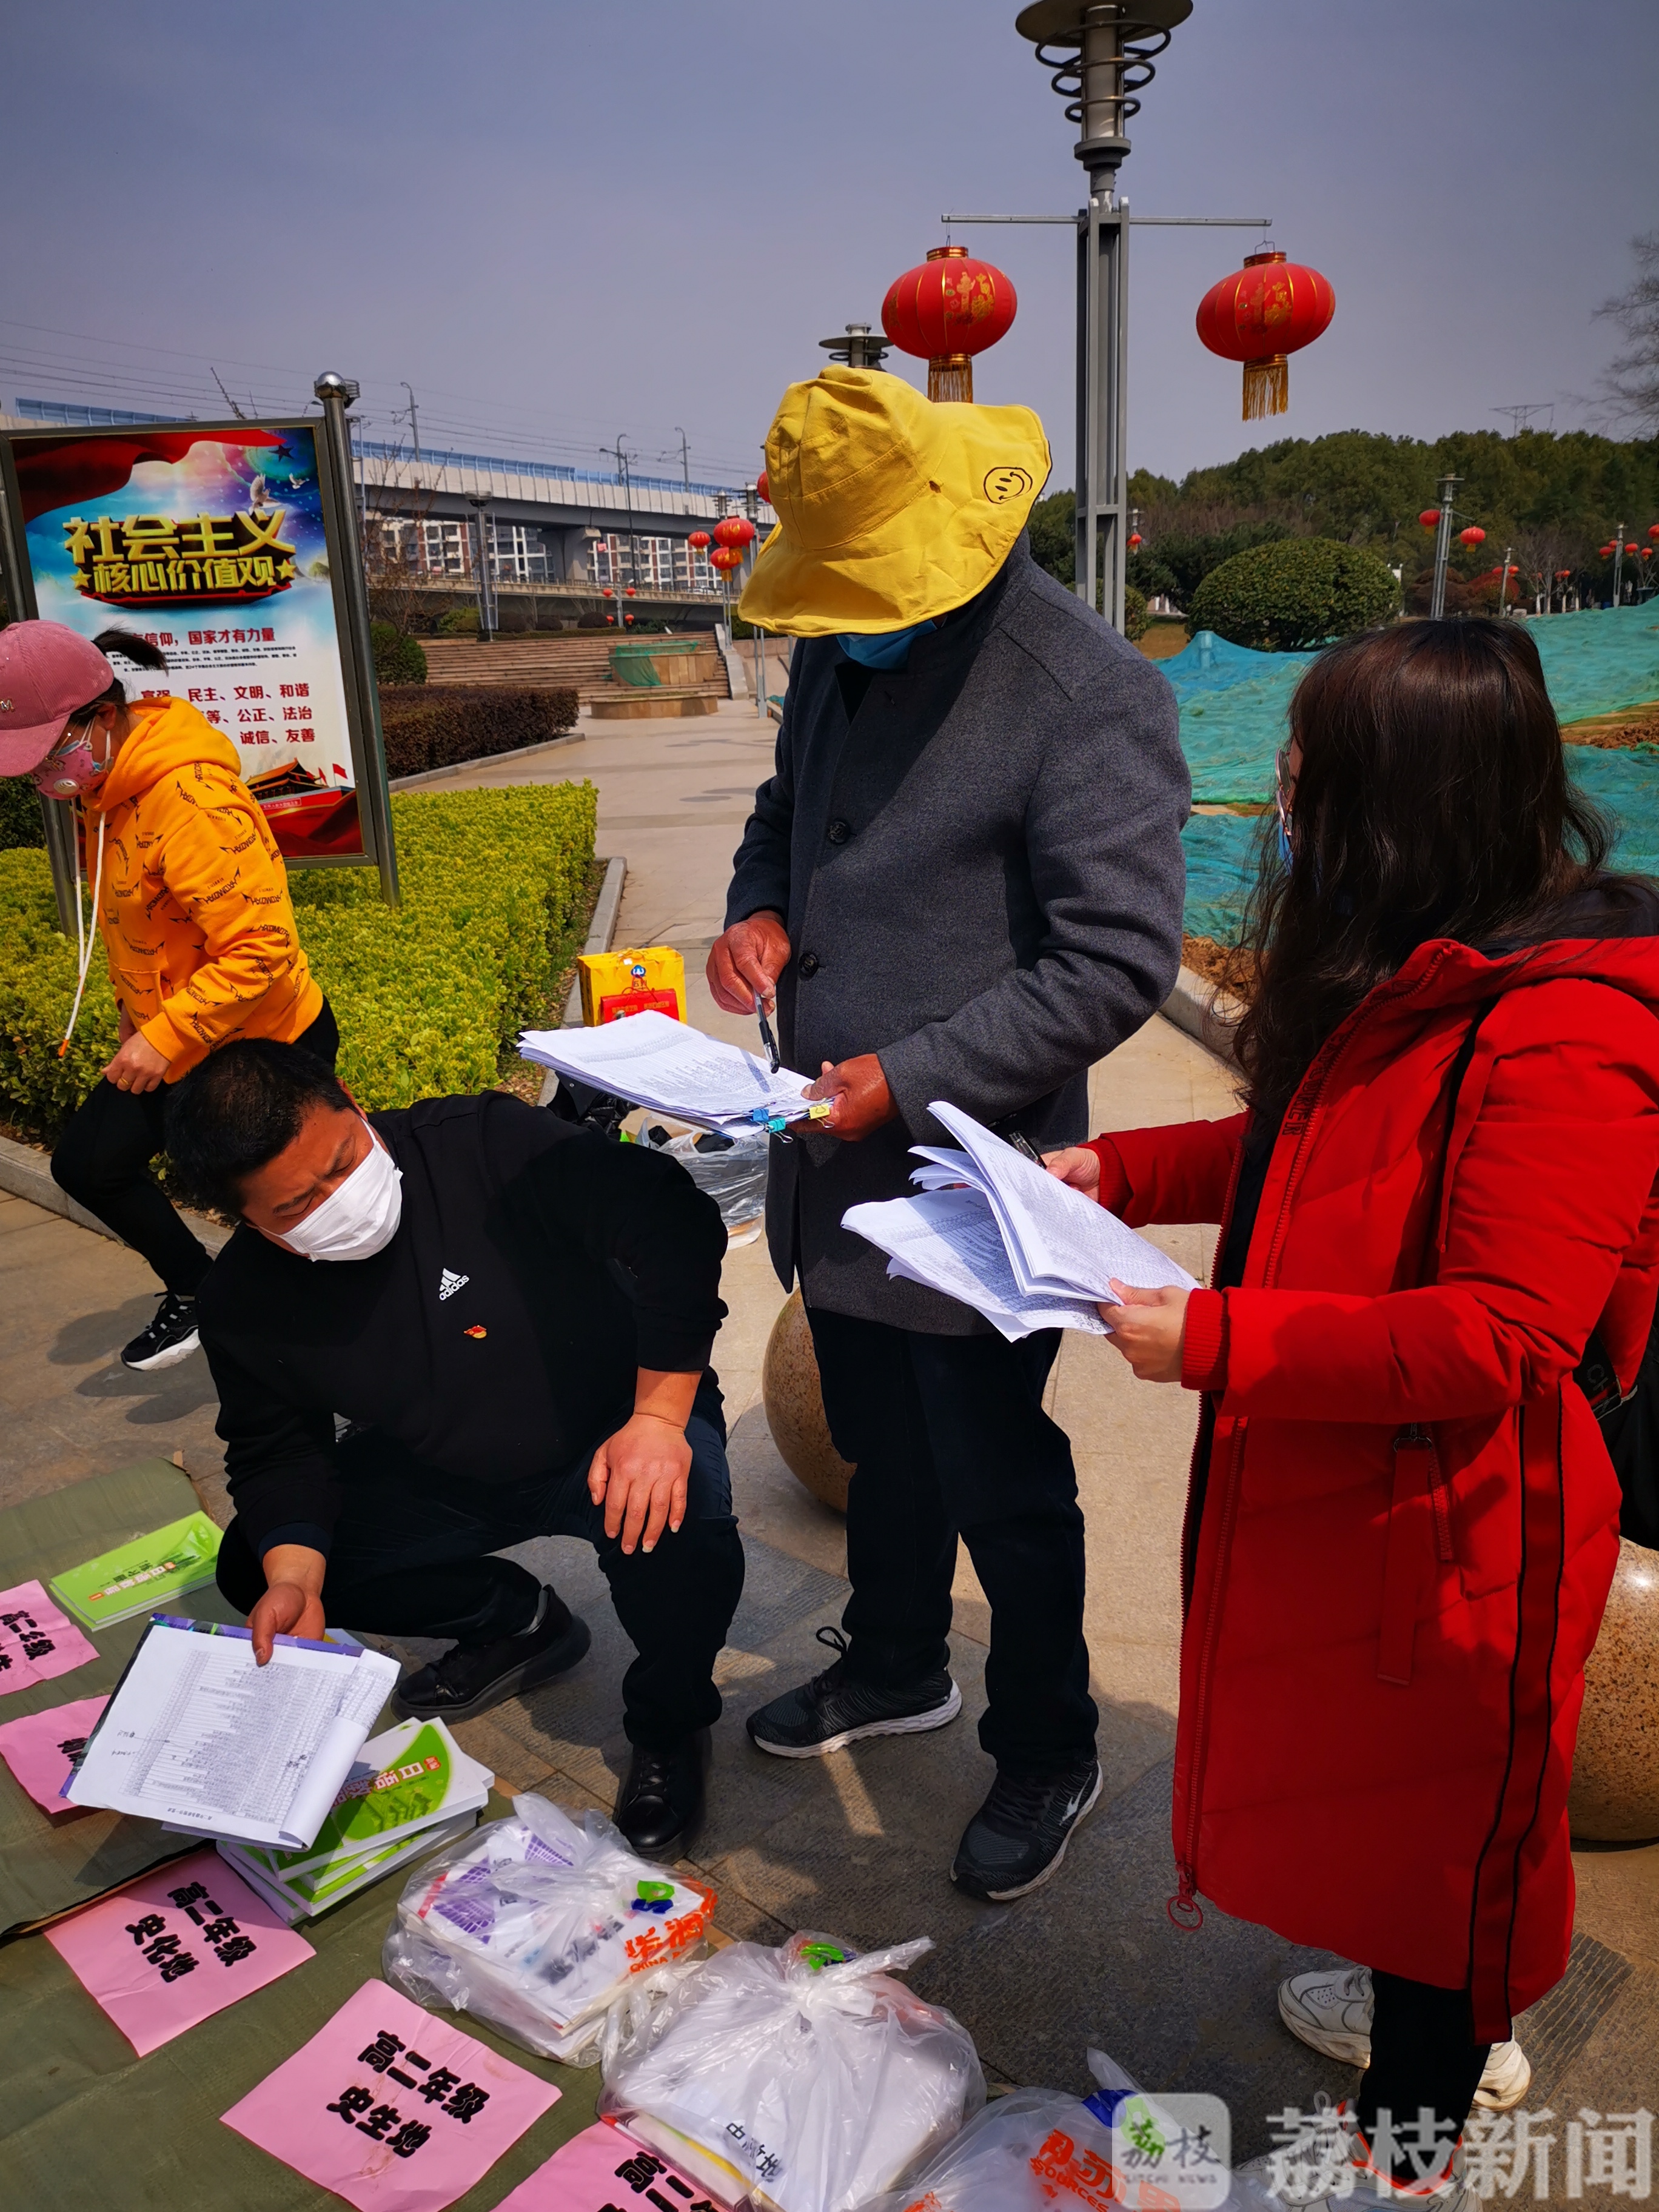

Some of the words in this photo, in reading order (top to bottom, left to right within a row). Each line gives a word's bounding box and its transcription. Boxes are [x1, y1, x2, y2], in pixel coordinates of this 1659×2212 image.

[62, 509, 297, 564] 社会主义
[93, 556, 276, 593] 核心价值观
[439, 1275, 470, 1301] adidas
[125, 1914, 200, 1983] 史化地
[167, 1881, 257, 1967] 高二年级
[357, 2029, 491, 2124] 高二年级
[326, 2086, 432, 2158] 史生地
[614, 2151, 721, 2212] 高二
